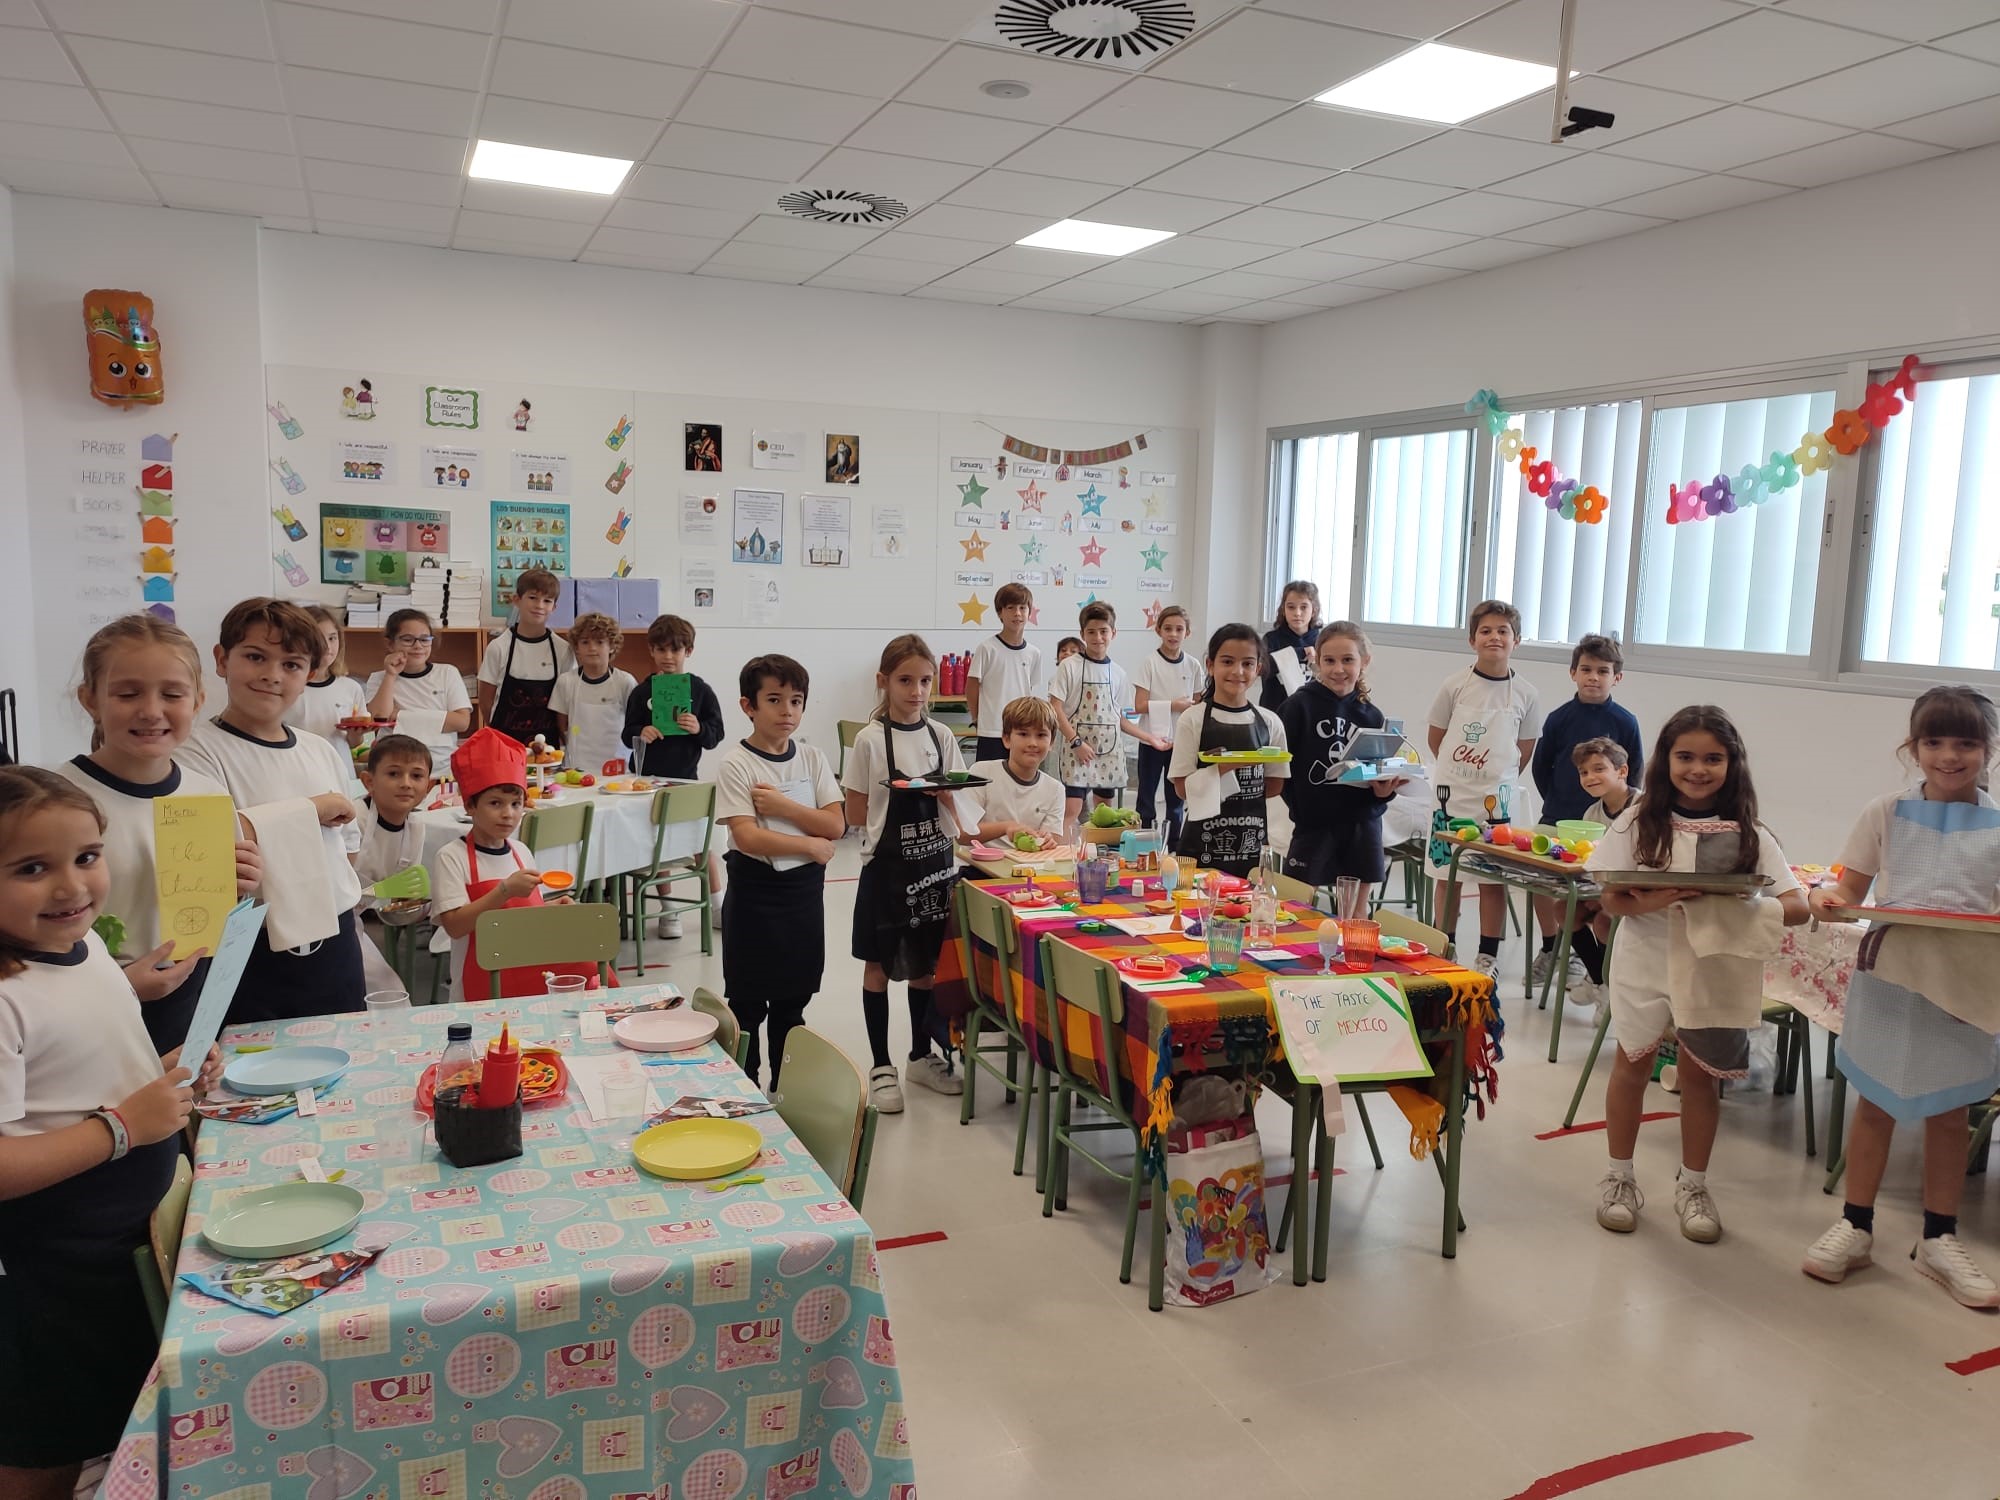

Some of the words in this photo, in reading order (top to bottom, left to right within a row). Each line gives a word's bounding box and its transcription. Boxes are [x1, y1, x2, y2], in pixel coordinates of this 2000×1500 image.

[433, 401, 471, 411] Classroom
[441, 409, 462, 418] Rules
[81, 439, 126, 456] PRAYER
[81, 470, 126, 485] HELPER
[958, 460, 983, 470] January
[1083, 470, 1103, 479] March
[1151, 475, 1166, 484] April
[496, 505, 509, 513] LOS
[510, 506, 535, 514] BUENOS
[536, 507, 566, 515] MODALES
[967, 515, 982, 525] May
[1148, 524, 1169, 533] Agust
[957, 574, 991, 583] September
[1452, 744, 1491, 770] Chef
[1202, 815, 1264, 831] CHONGQING
[1299, 993, 1326, 1011] THE
[1331, 991, 1370, 1008] TASTE
[1305, 1019, 1322, 1035] OF
[1336, 1018, 1388, 1037] MEXICO
